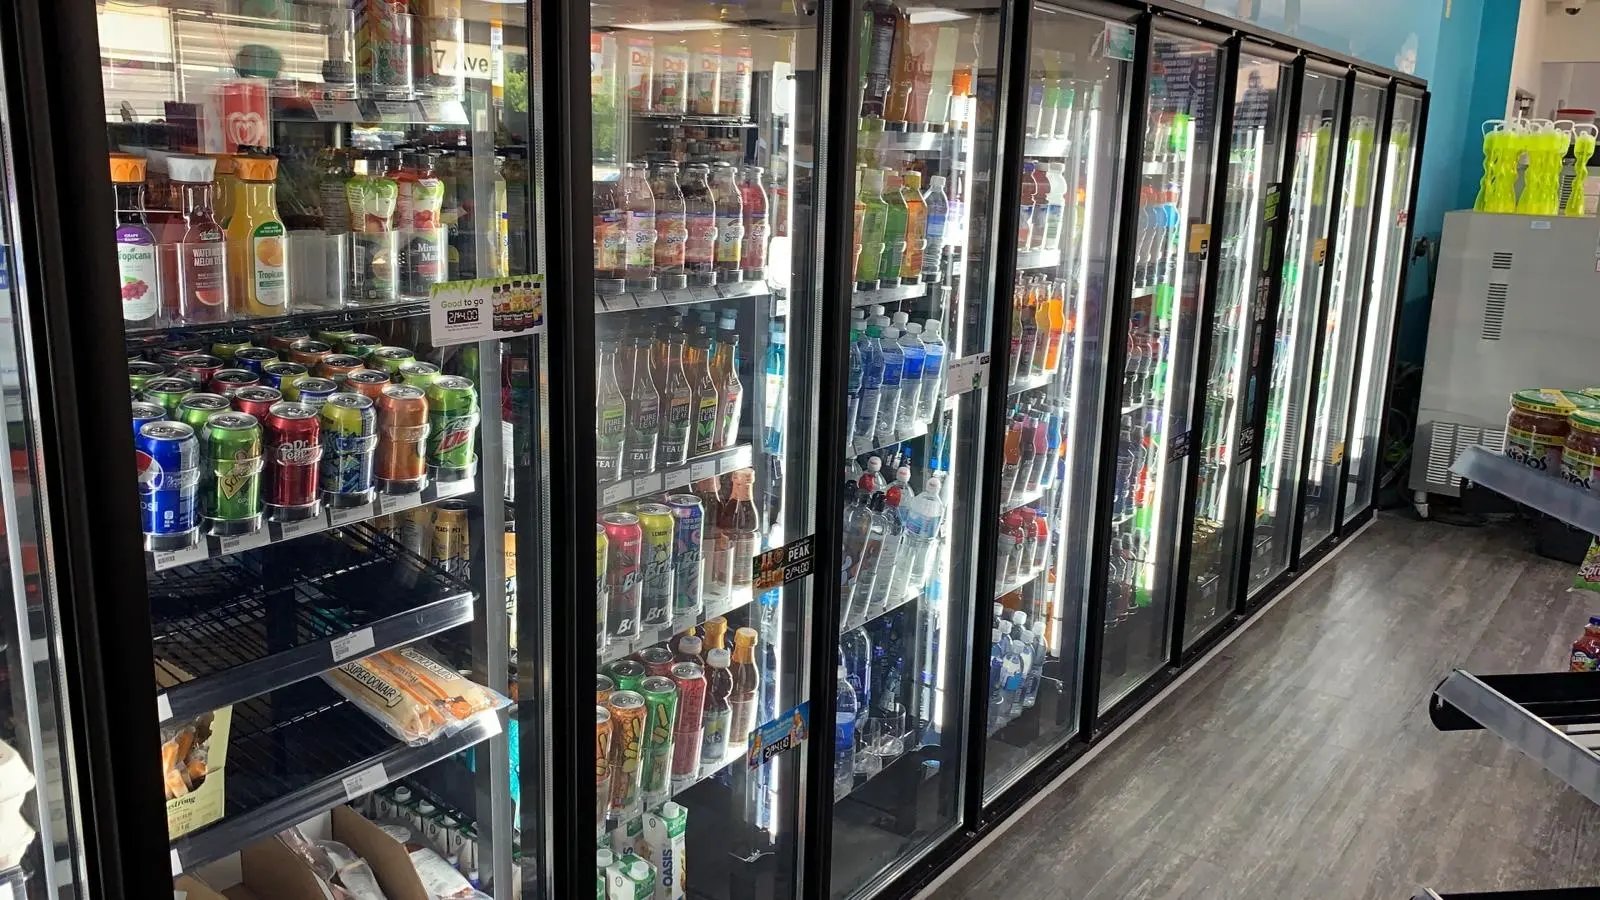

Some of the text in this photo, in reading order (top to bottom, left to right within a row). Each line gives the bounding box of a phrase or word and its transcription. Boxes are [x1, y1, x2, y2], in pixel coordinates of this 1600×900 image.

[434, 49, 446, 69] 7
[118, 251, 151, 263] ropicana
[441, 299, 463, 309] Good
[473, 298, 484, 308] go
[292, 439, 308, 451] Dr
[788, 543, 810, 562] PEAK
[663, 849, 673, 887] OASIS
